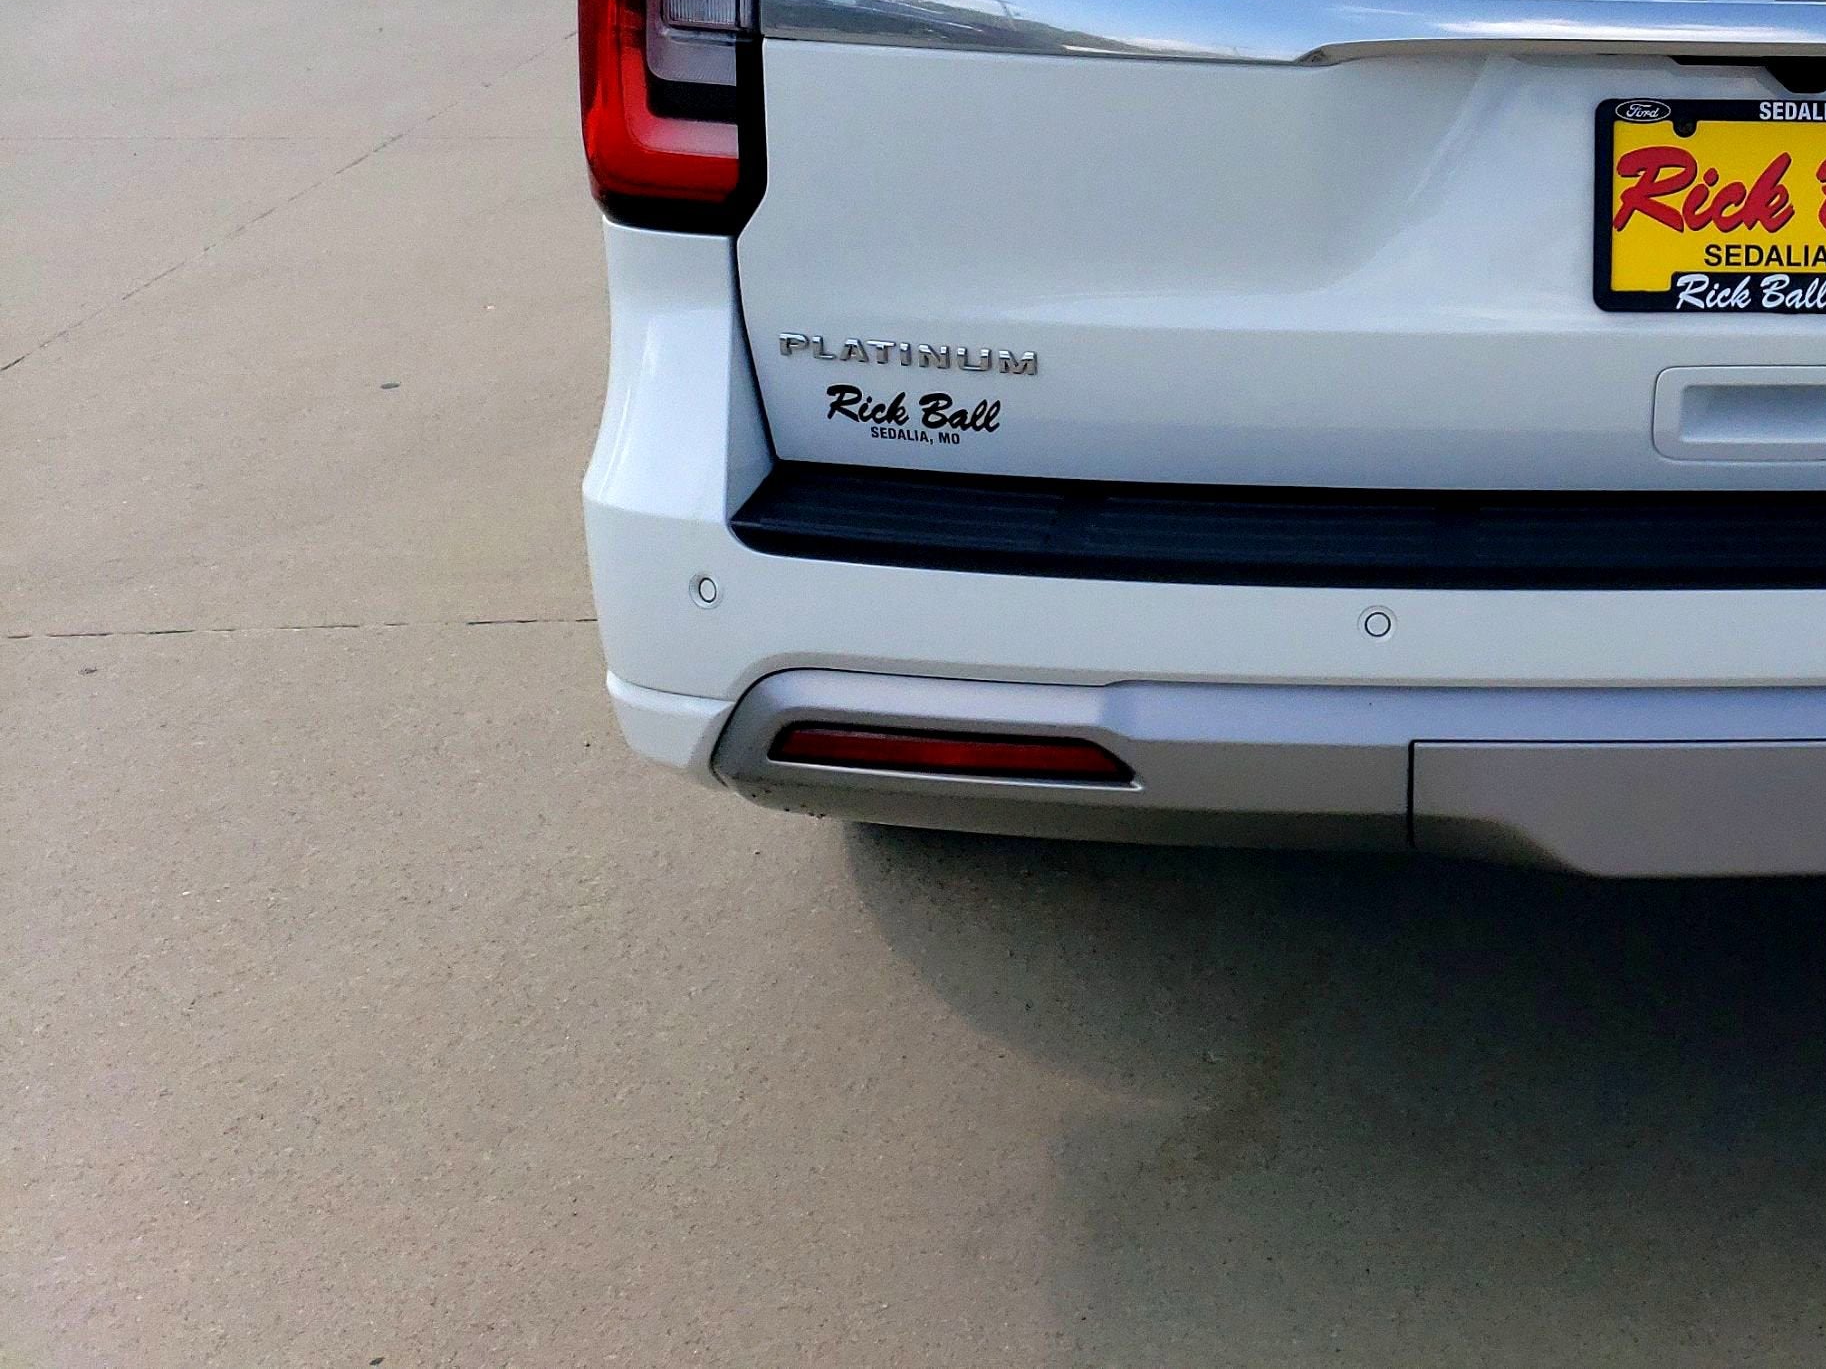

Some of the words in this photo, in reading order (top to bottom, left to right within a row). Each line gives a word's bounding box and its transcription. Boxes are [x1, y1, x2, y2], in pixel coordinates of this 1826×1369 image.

[1626, 103, 1660, 118] Ford
[1612, 146, 1796, 234] Rick
[1675, 274, 1752, 310] Rick
[778, 331, 1039, 376] PLATINUM
[826, 383, 910, 425] Rick
[918, 392, 1002, 433] Ball
[870, 426, 934, 445] SEDALIA,
[938, 432, 961, 445] MO
